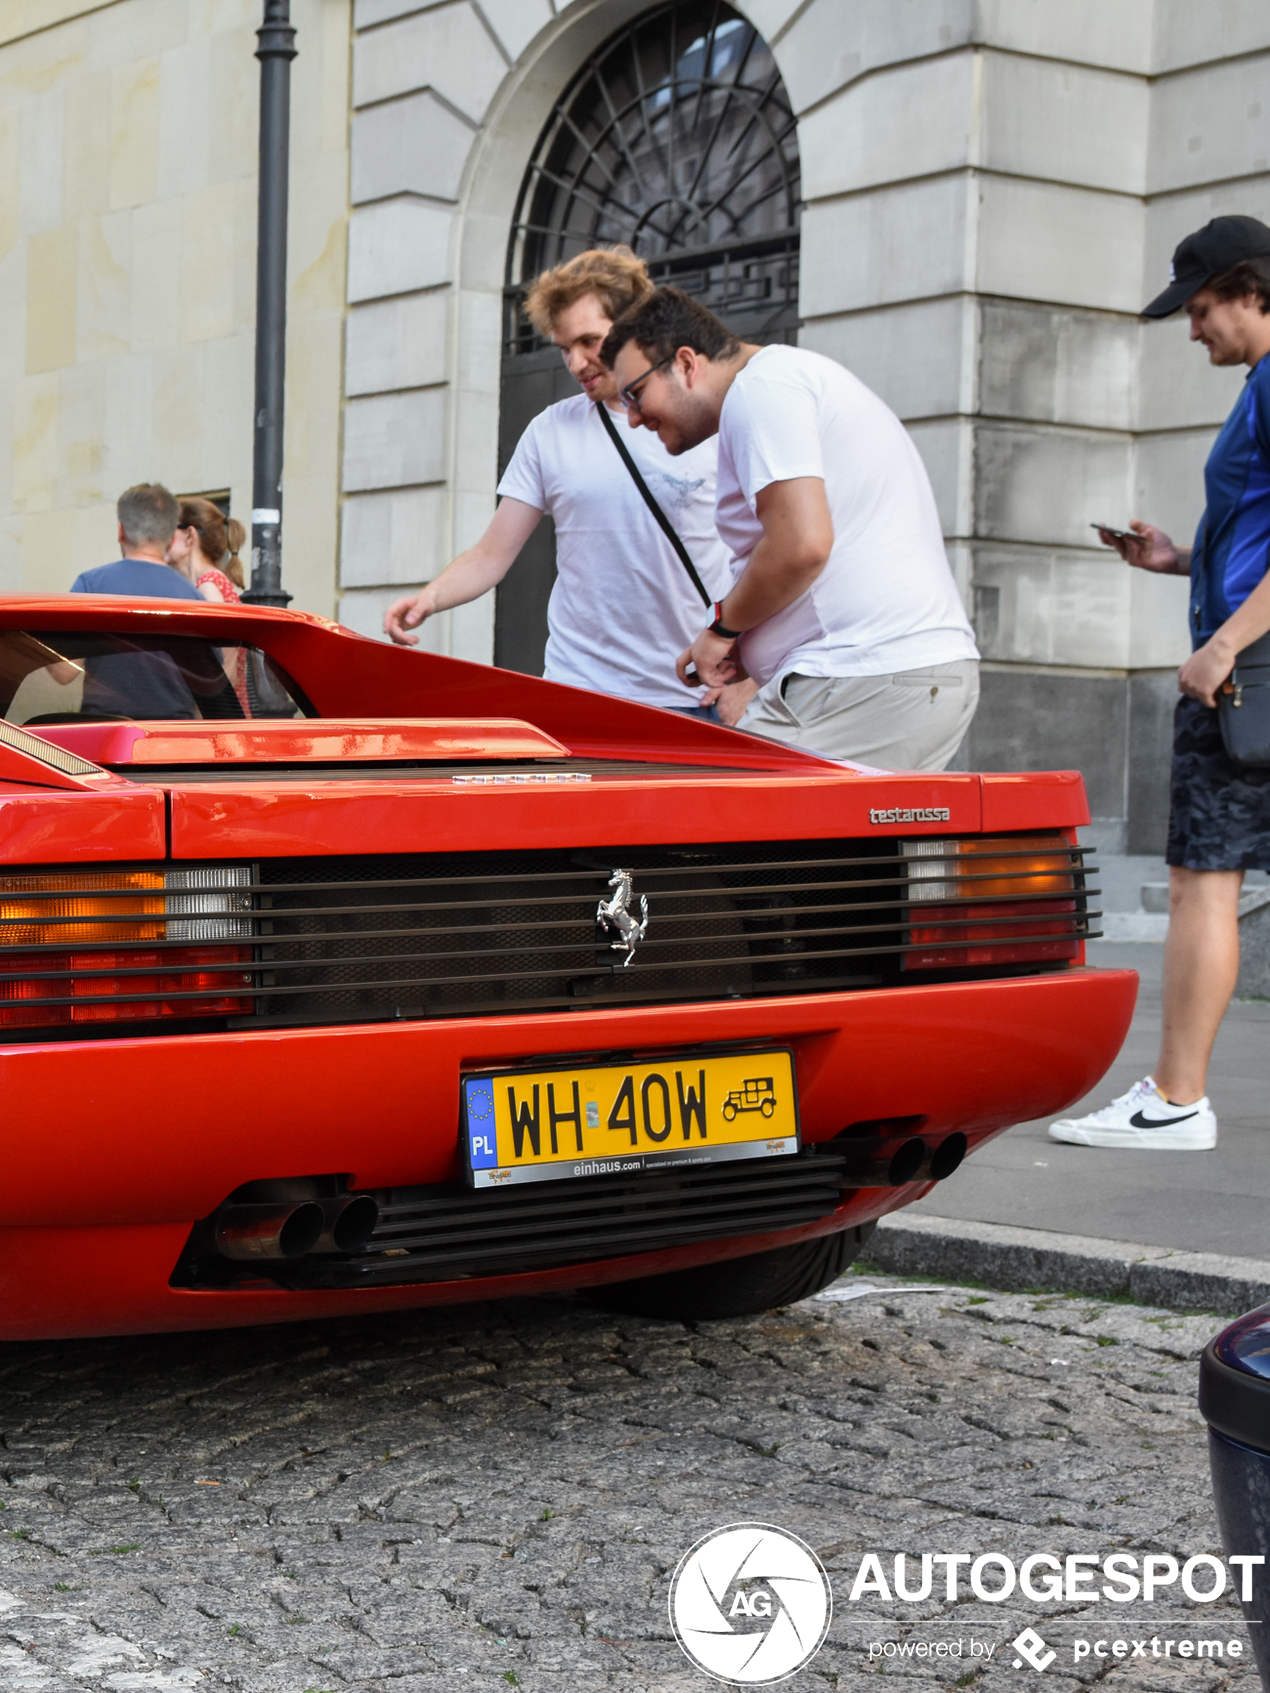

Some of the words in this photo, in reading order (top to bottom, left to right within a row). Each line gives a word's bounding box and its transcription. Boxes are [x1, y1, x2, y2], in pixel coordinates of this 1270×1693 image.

[869, 807, 950, 824] testarossa
[506, 1081, 583, 1158] WH
[606, 1069, 707, 1146] 40W
[473, 1135, 493, 1156] PL
[573, 1159, 641, 1176] einhaus.com
